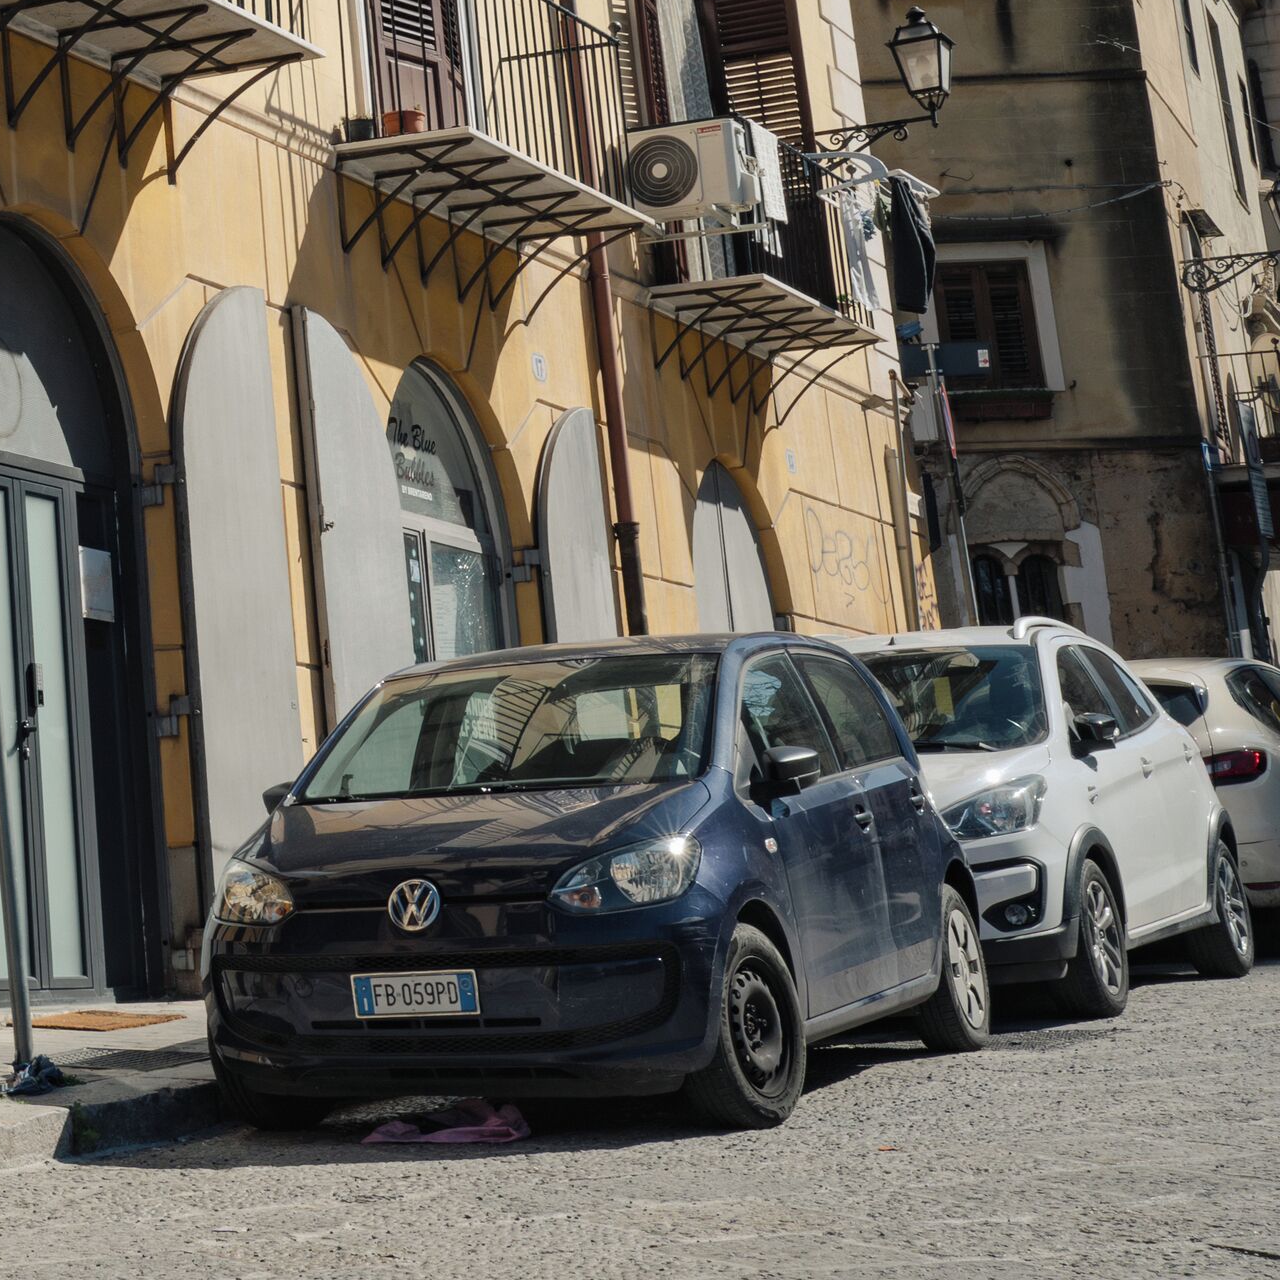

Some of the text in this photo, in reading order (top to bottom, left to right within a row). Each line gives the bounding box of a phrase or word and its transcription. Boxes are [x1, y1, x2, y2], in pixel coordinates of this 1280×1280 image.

[388, 417, 436, 455] The Blue
[395, 452, 435, 486] Bubbles
[373, 983, 396, 1007] FB
[401, 980, 459, 1006] 059PD
